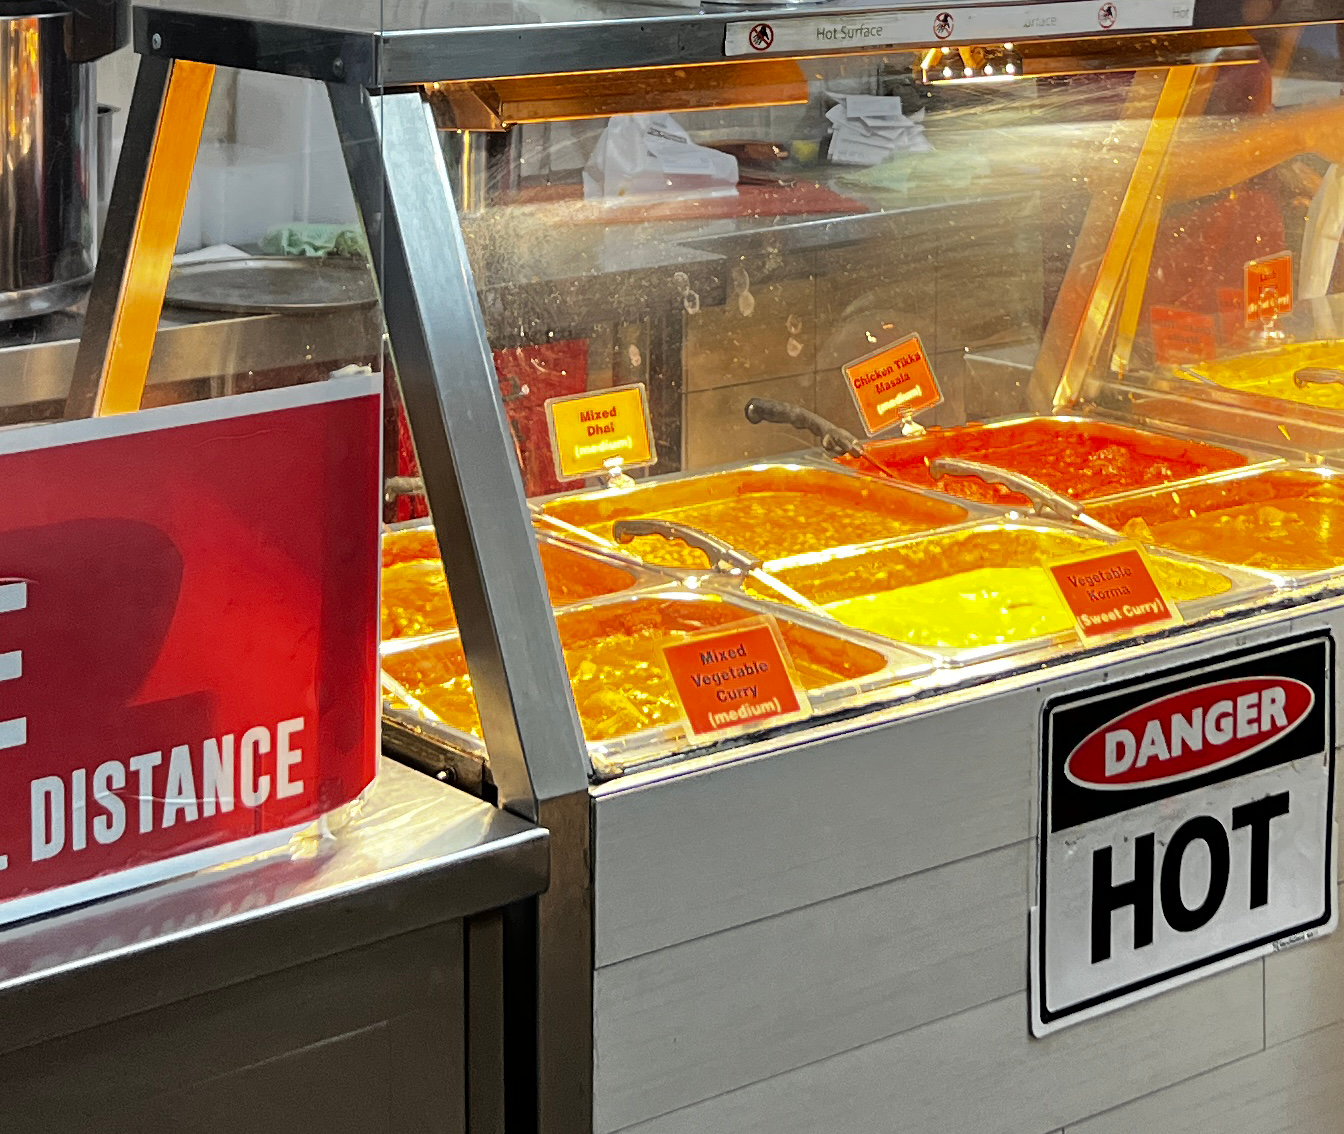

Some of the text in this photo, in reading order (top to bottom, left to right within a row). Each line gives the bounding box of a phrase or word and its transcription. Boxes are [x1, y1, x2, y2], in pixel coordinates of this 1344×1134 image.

[816, 24, 883, 40] Hot Surface
[854, 352, 921, 388] Chicken Tikka
[580, 406, 616, 422] Mixed
[1067, 566, 1132, 587] Vegetable
[1087, 586, 1131, 602] Korma
[1077, 598, 1164, 630] (Sweet Curry)
[699, 644, 746, 665] Mixed
[691, 661, 769, 687] Vegetable
[717, 685, 757, 702] Curry
[708, 697, 781, 728] (medium)
[1104, 686, 1289, 777] DANGER
[31, 717, 306, 864] DISTANCE
[1091, 791, 1290, 965] HOT
